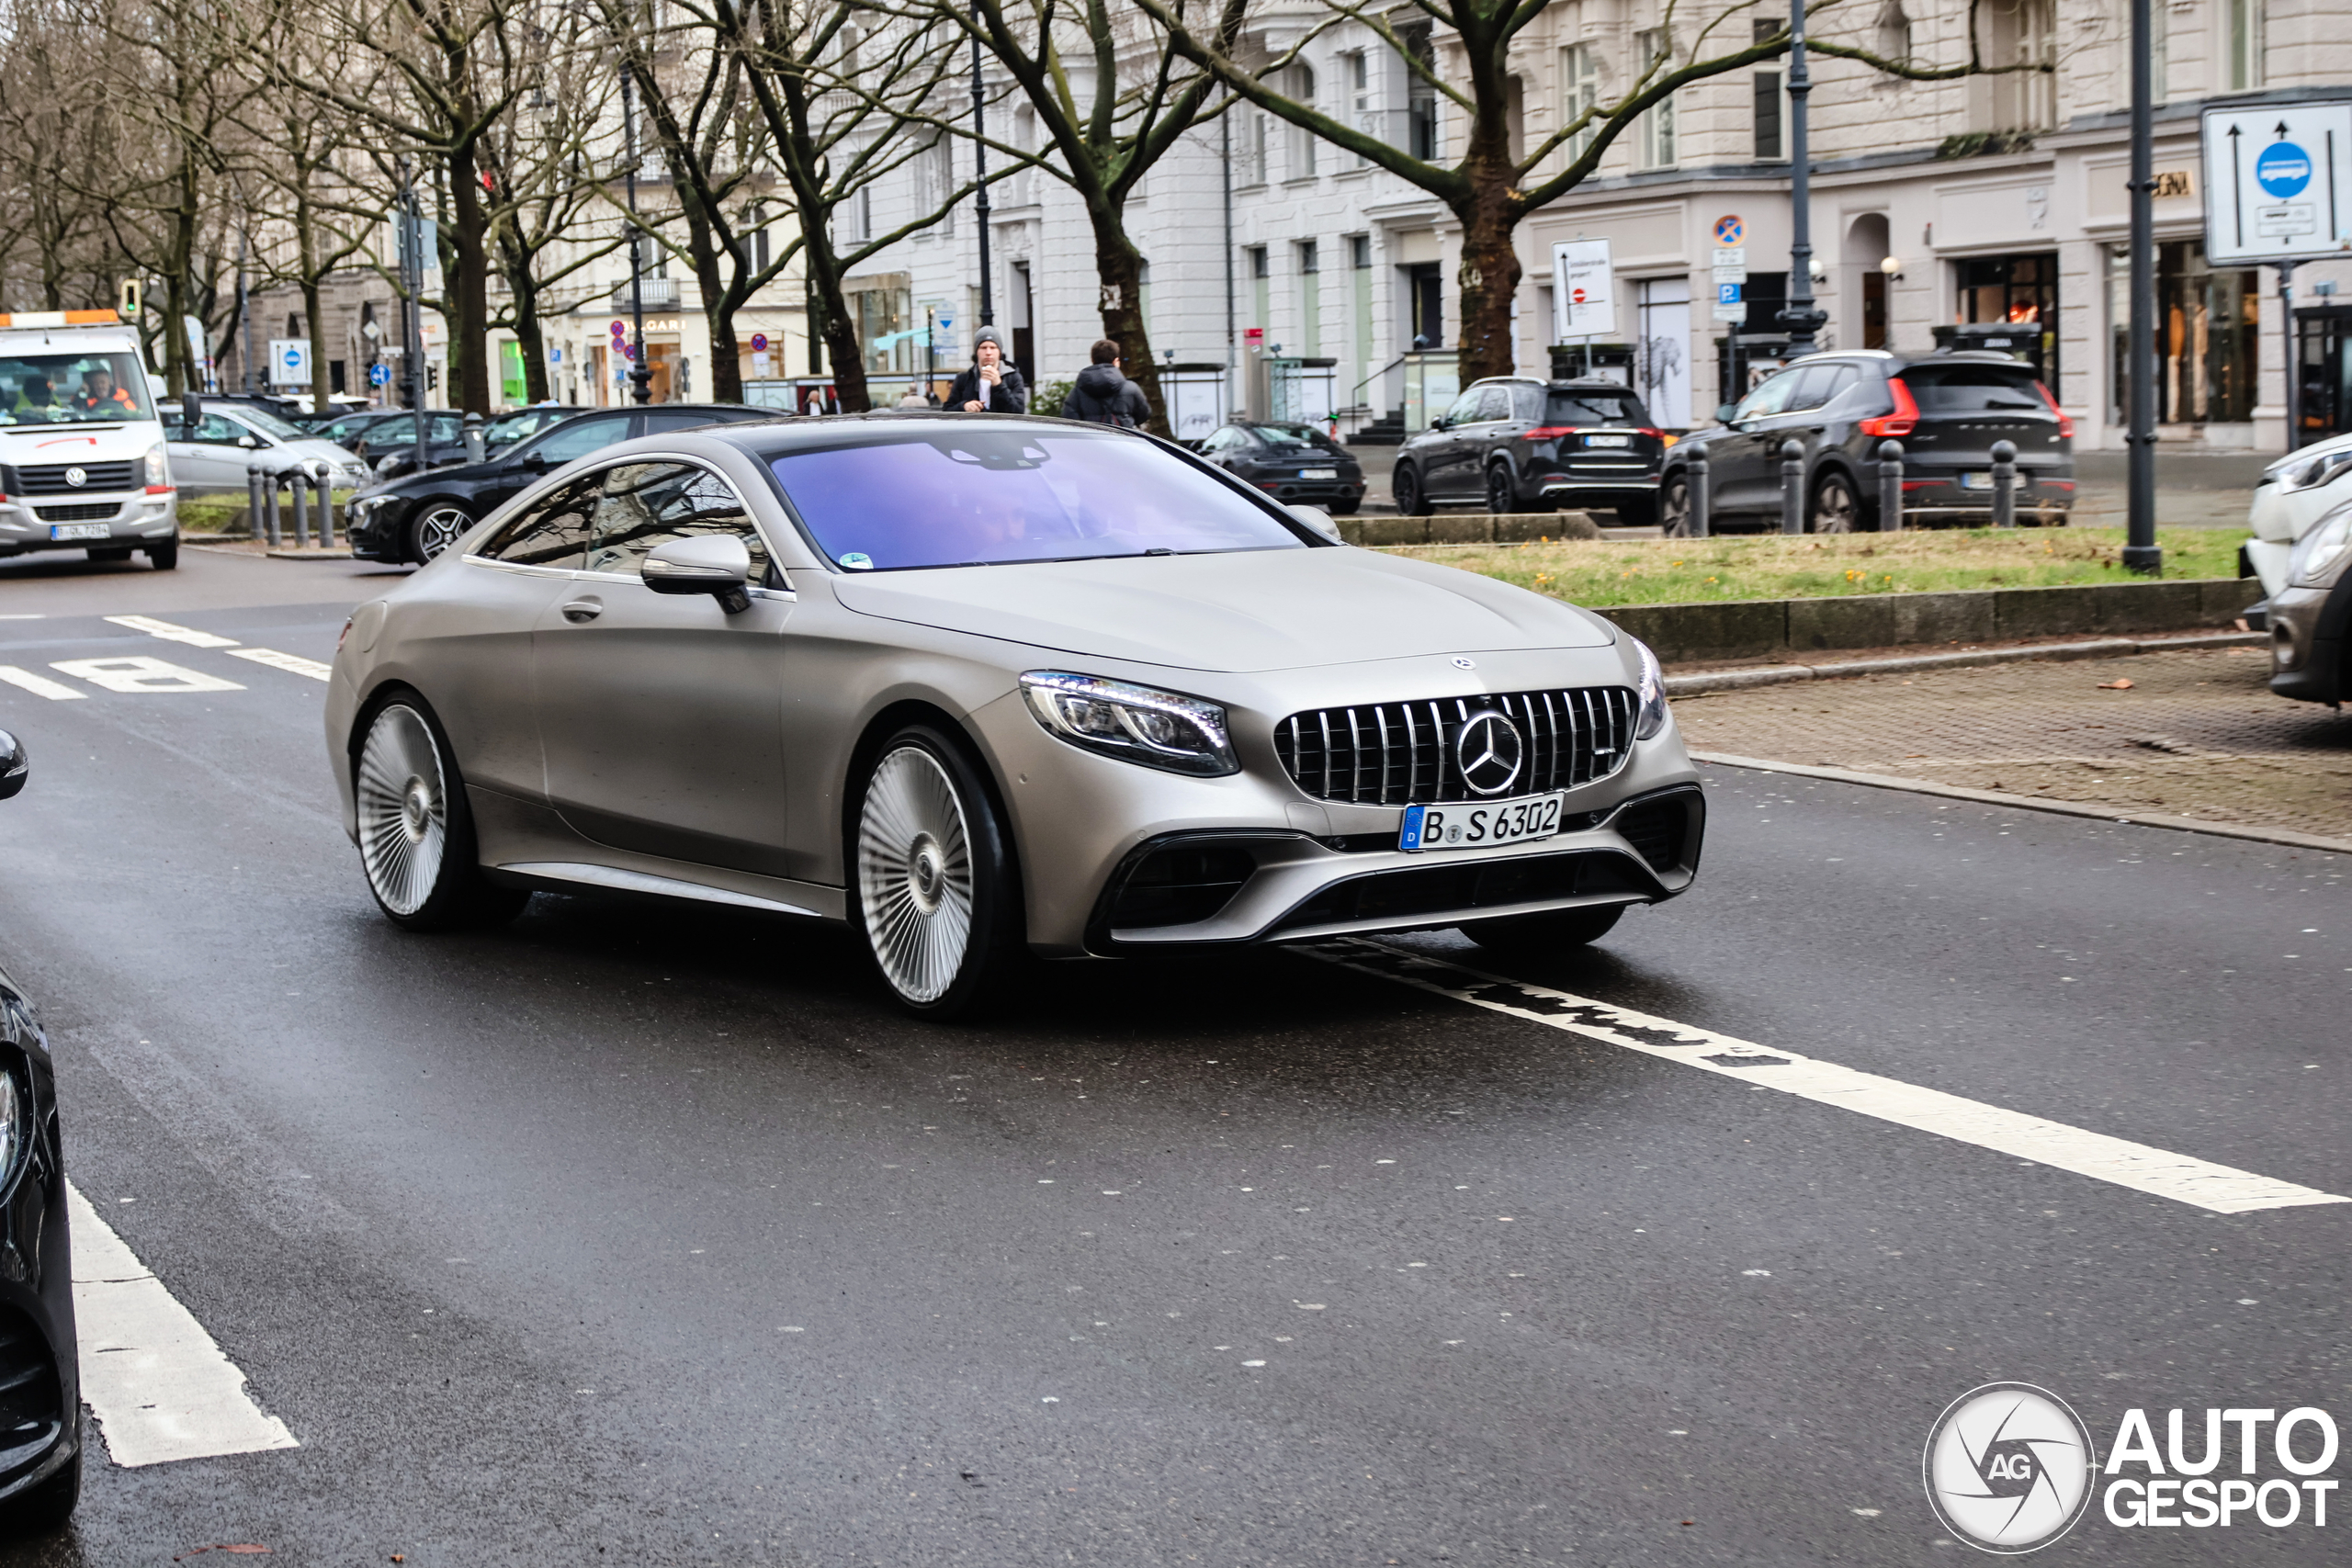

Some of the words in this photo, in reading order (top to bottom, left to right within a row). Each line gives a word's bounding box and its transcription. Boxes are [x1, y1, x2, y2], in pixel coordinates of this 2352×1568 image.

[1423, 811, 1444, 843] B
[1466, 810, 1488, 841] S
[1493, 798, 1559, 839] 6302
[1407, 832, 1416, 842] D
